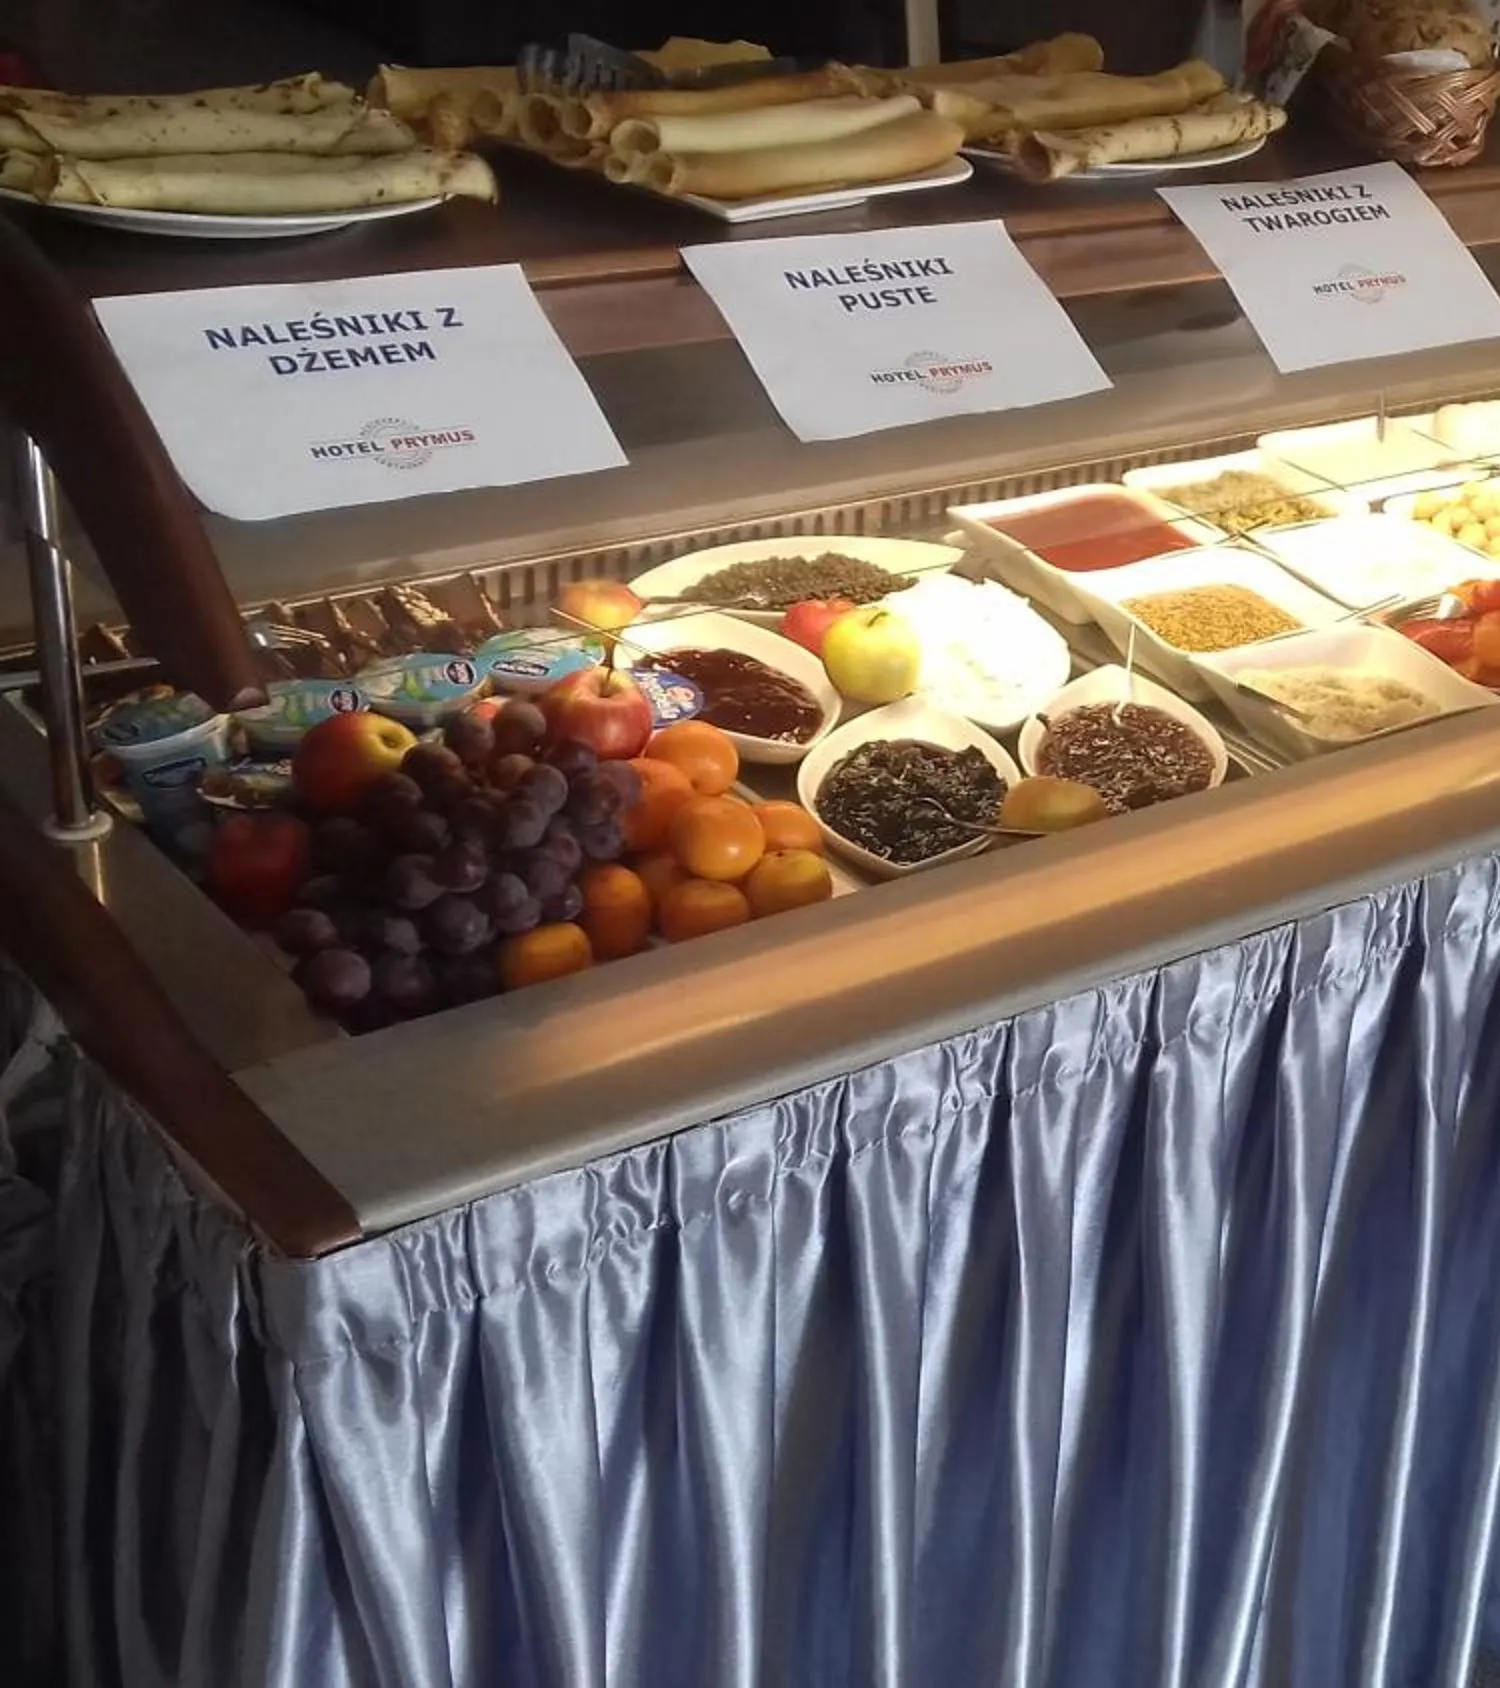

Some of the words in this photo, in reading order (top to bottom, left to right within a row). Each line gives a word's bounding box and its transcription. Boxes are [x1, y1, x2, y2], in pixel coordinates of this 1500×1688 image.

[1220, 186, 1352, 212] NALEŚNIKI
[1350, 184, 1373, 199] Z
[1241, 204, 1391, 233] TWAROGIEM
[784, 257, 955, 289] NALEŚNIKI
[838, 286, 938, 312] PUSTE
[1312, 281, 1355, 295] HOTEL
[203, 311, 429, 350] NALEŚNIKI
[435, 307, 464, 328] Z
[269, 340, 436, 375] DŻEMEM
[871, 369, 927, 383] HOTEL
[928, 361, 992, 377] PRYMUS
[310, 440, 385, 458] HOTEL
[390, 429, 475, 449] PRYMUS
